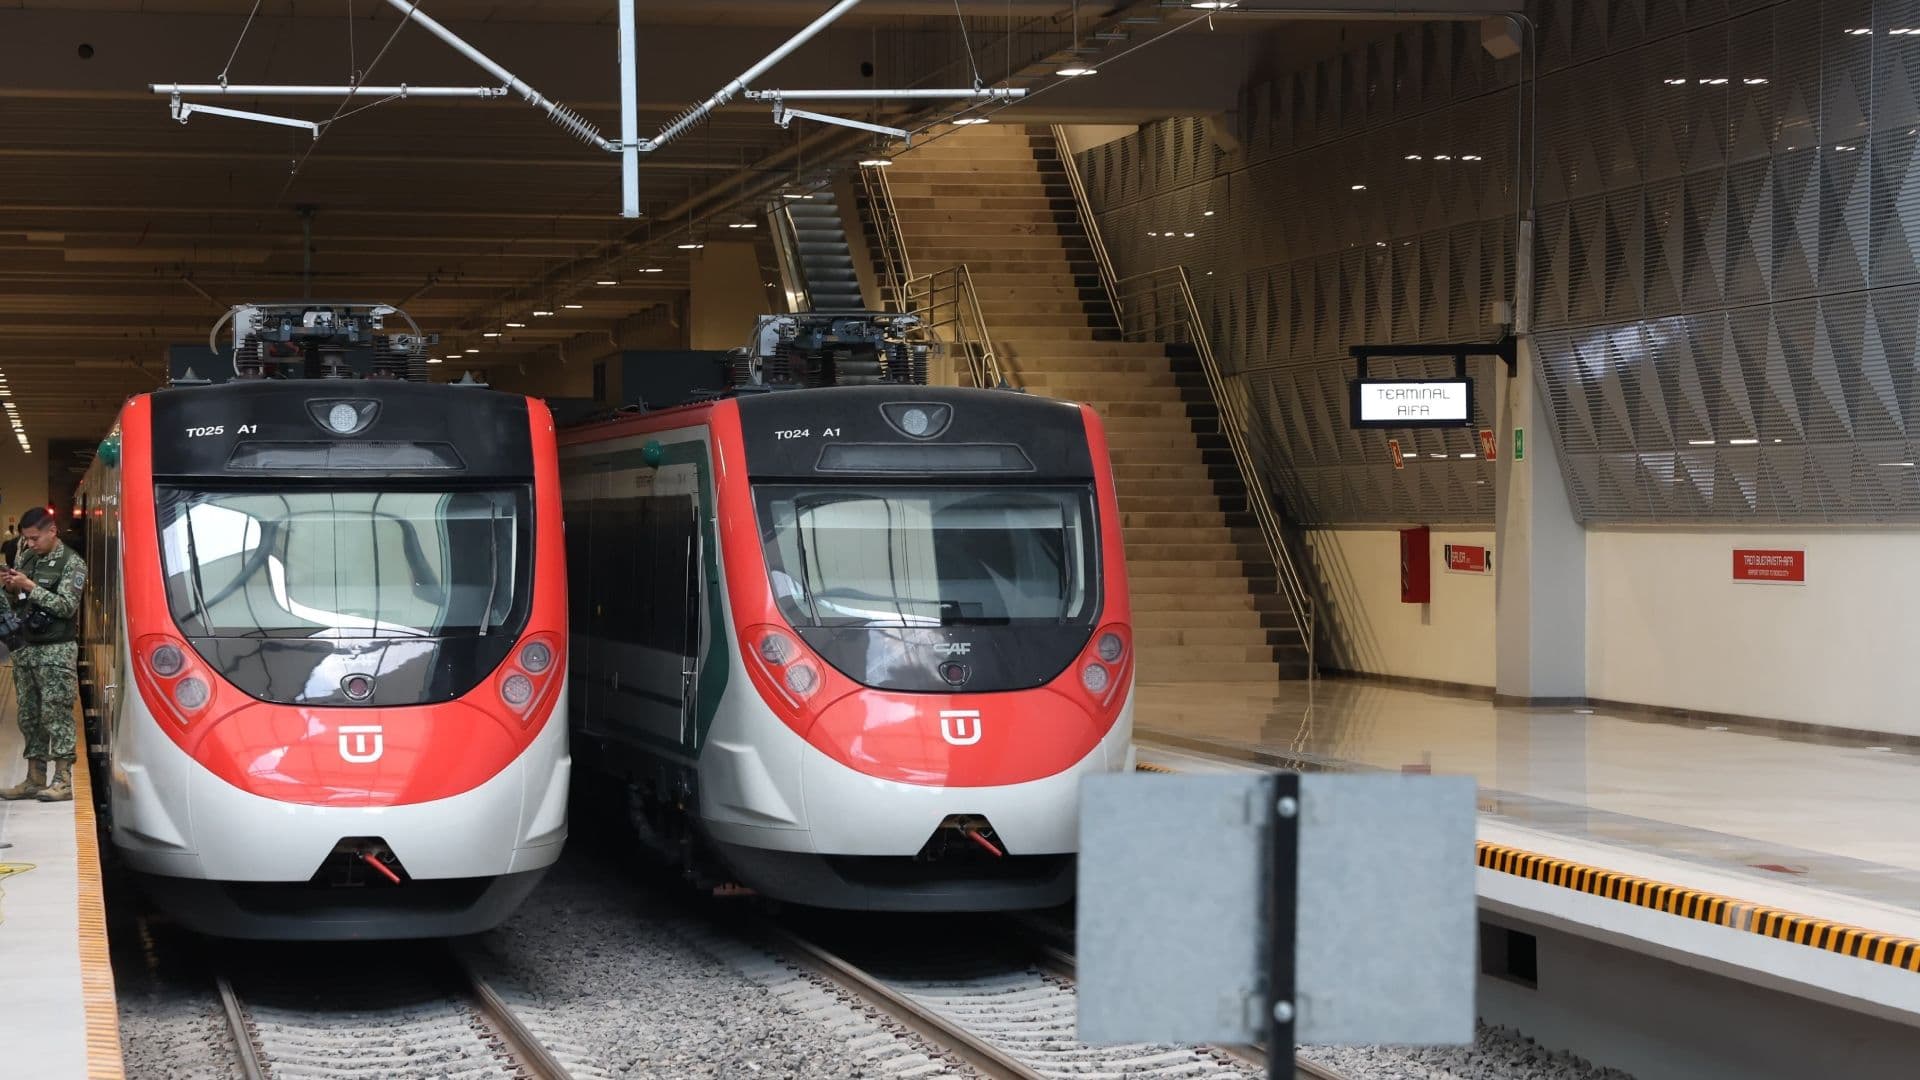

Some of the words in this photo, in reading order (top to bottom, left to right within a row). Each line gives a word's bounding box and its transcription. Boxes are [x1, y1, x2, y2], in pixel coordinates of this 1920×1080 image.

[1377, 388, 1450, 400] TERMINAL
[1397, 405, 1430, 416] AIFA
[186, 425, 224, 438] T025
[237, 424, 257, 434] A1
[774, 429, 810, 440] T024
[823, 428, 841, 437] A1
